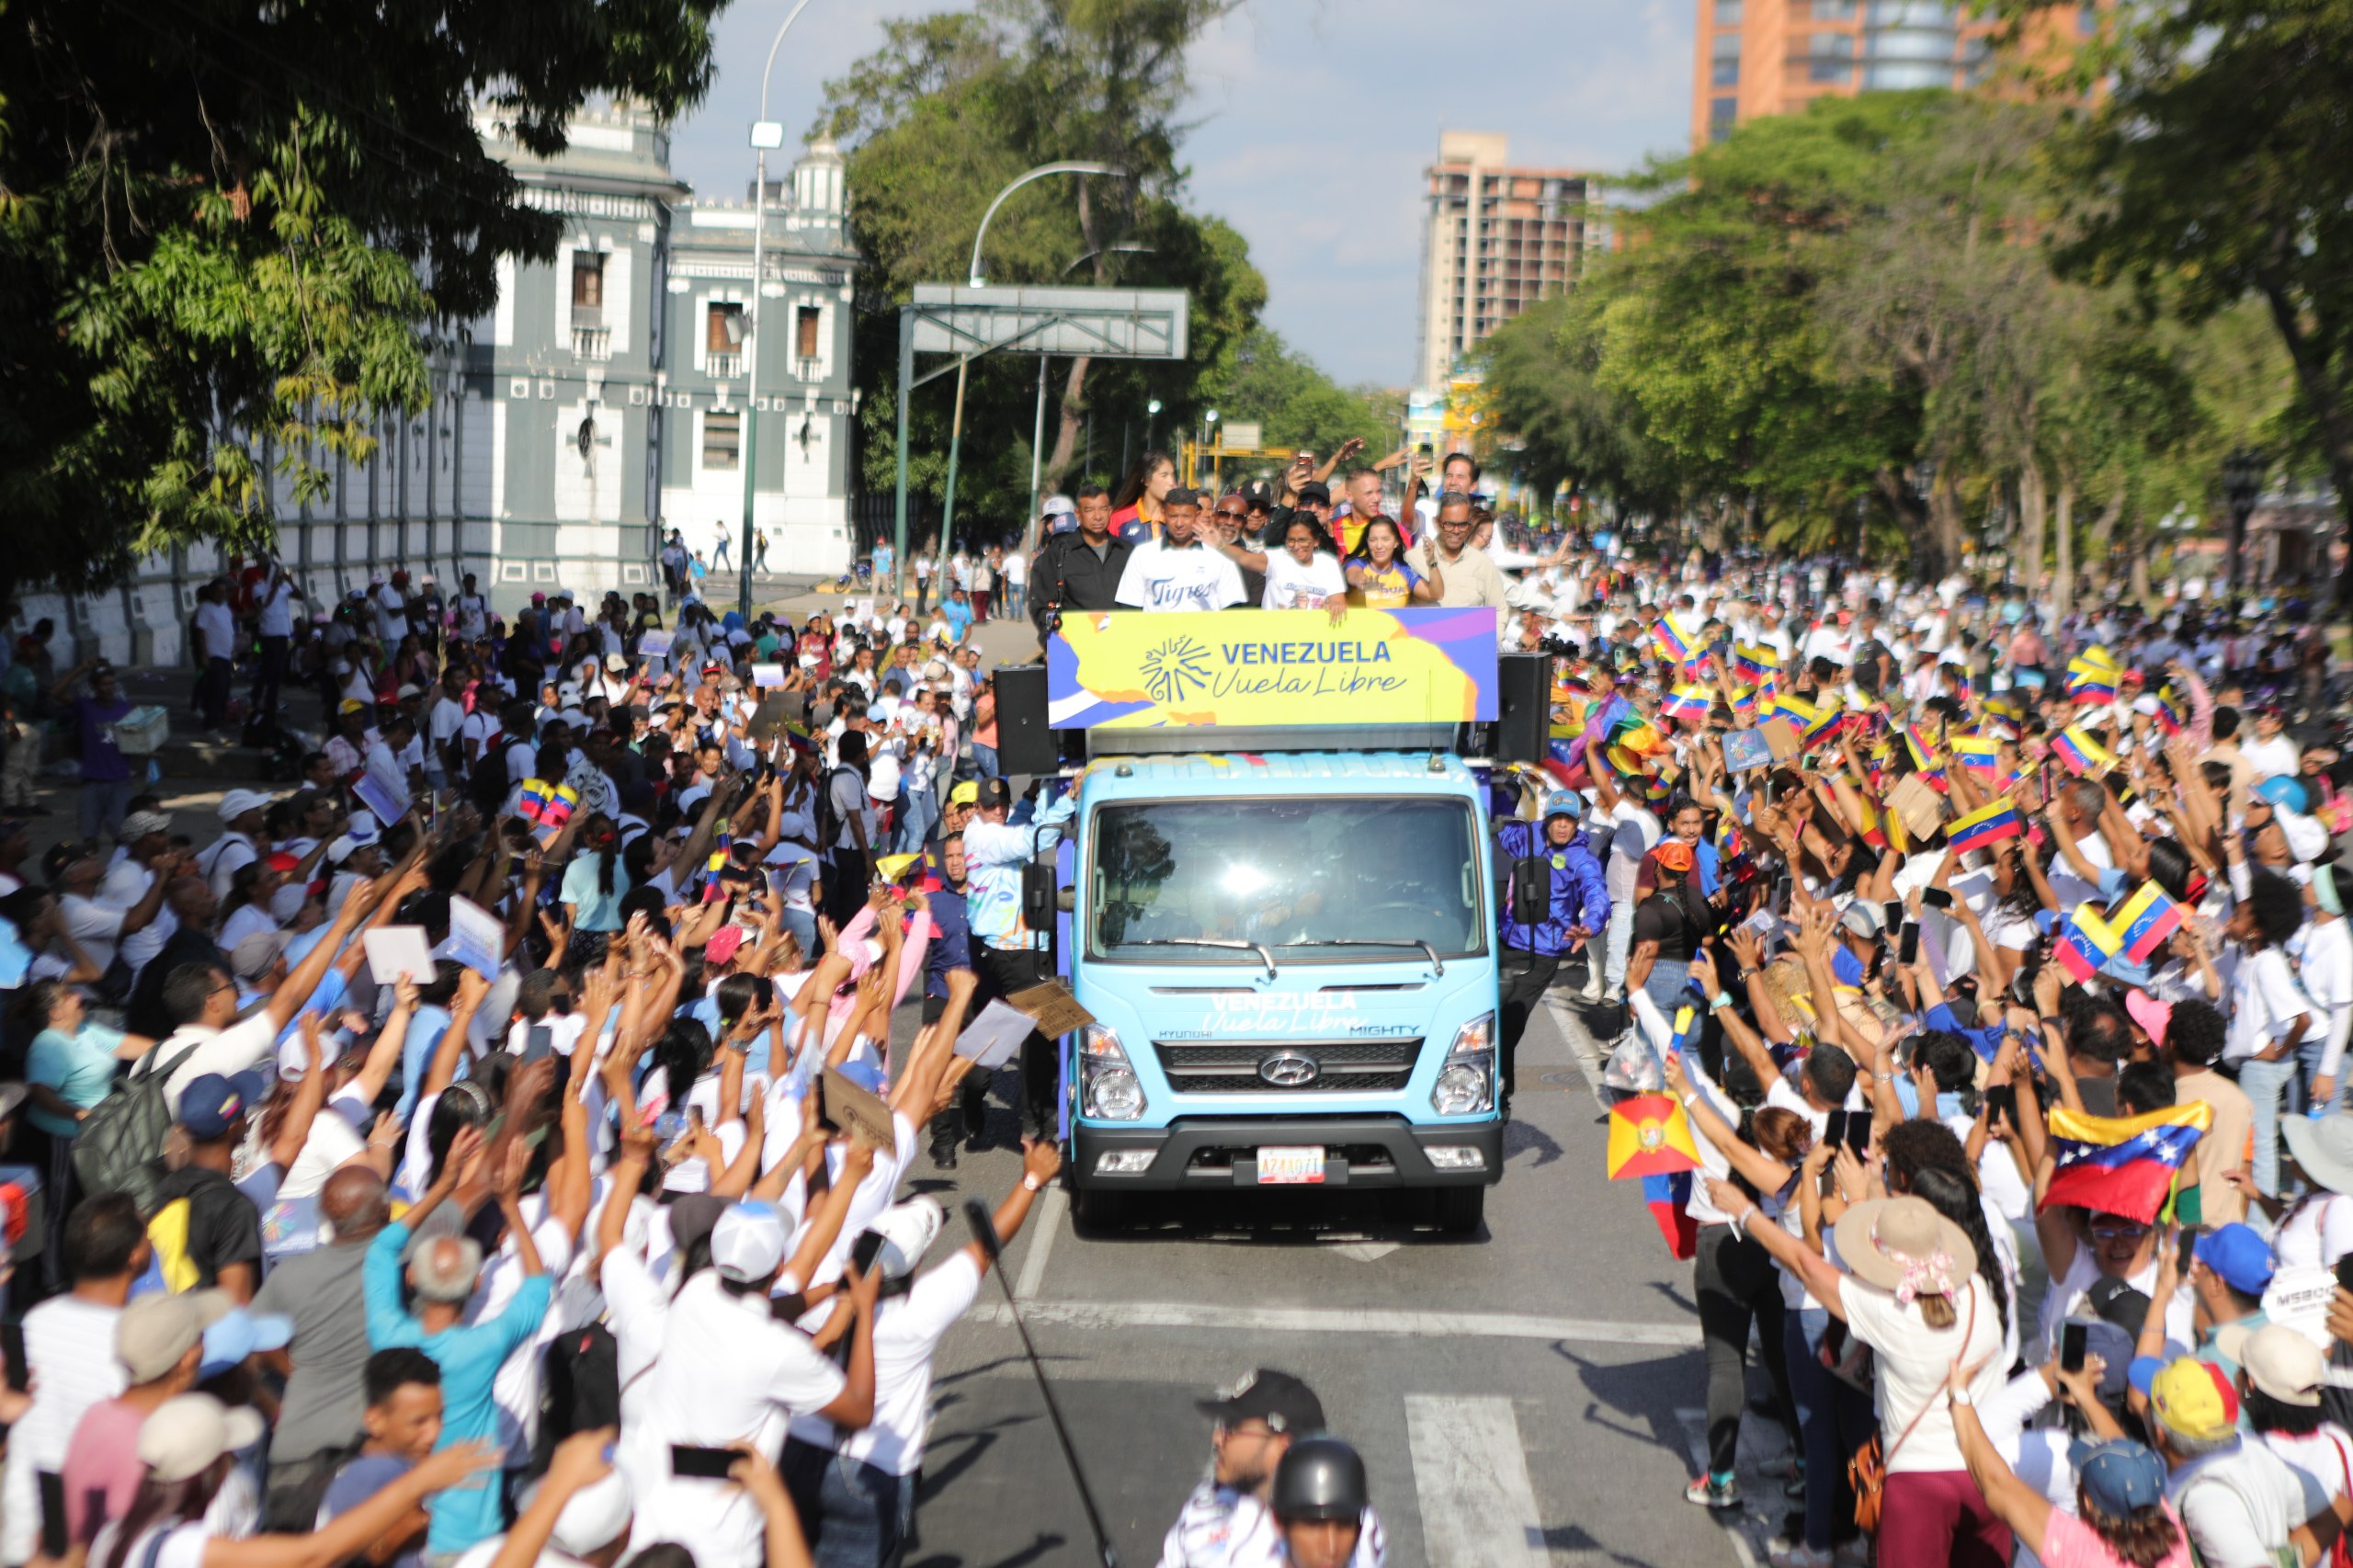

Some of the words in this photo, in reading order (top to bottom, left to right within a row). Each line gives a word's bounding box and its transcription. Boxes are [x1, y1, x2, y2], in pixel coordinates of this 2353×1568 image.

[1152, 576, 1214, 608] Tigres
[1222, 641, 1391, 665] VENEZUELA
[1212, 667, 1312, 698] Vuela
[1313, 666, 1407, 696] Libre
[1211, 992, 1357, 1011] VENEZUELA
[1199, 1011, 1287, 1032] Vuela
[1288, 1009, 1369, 1033] Libre
[1349, 1025, 1420, 1037] MIGHTY
[1159, 1030, 1212, 1039] HYUNDAI
